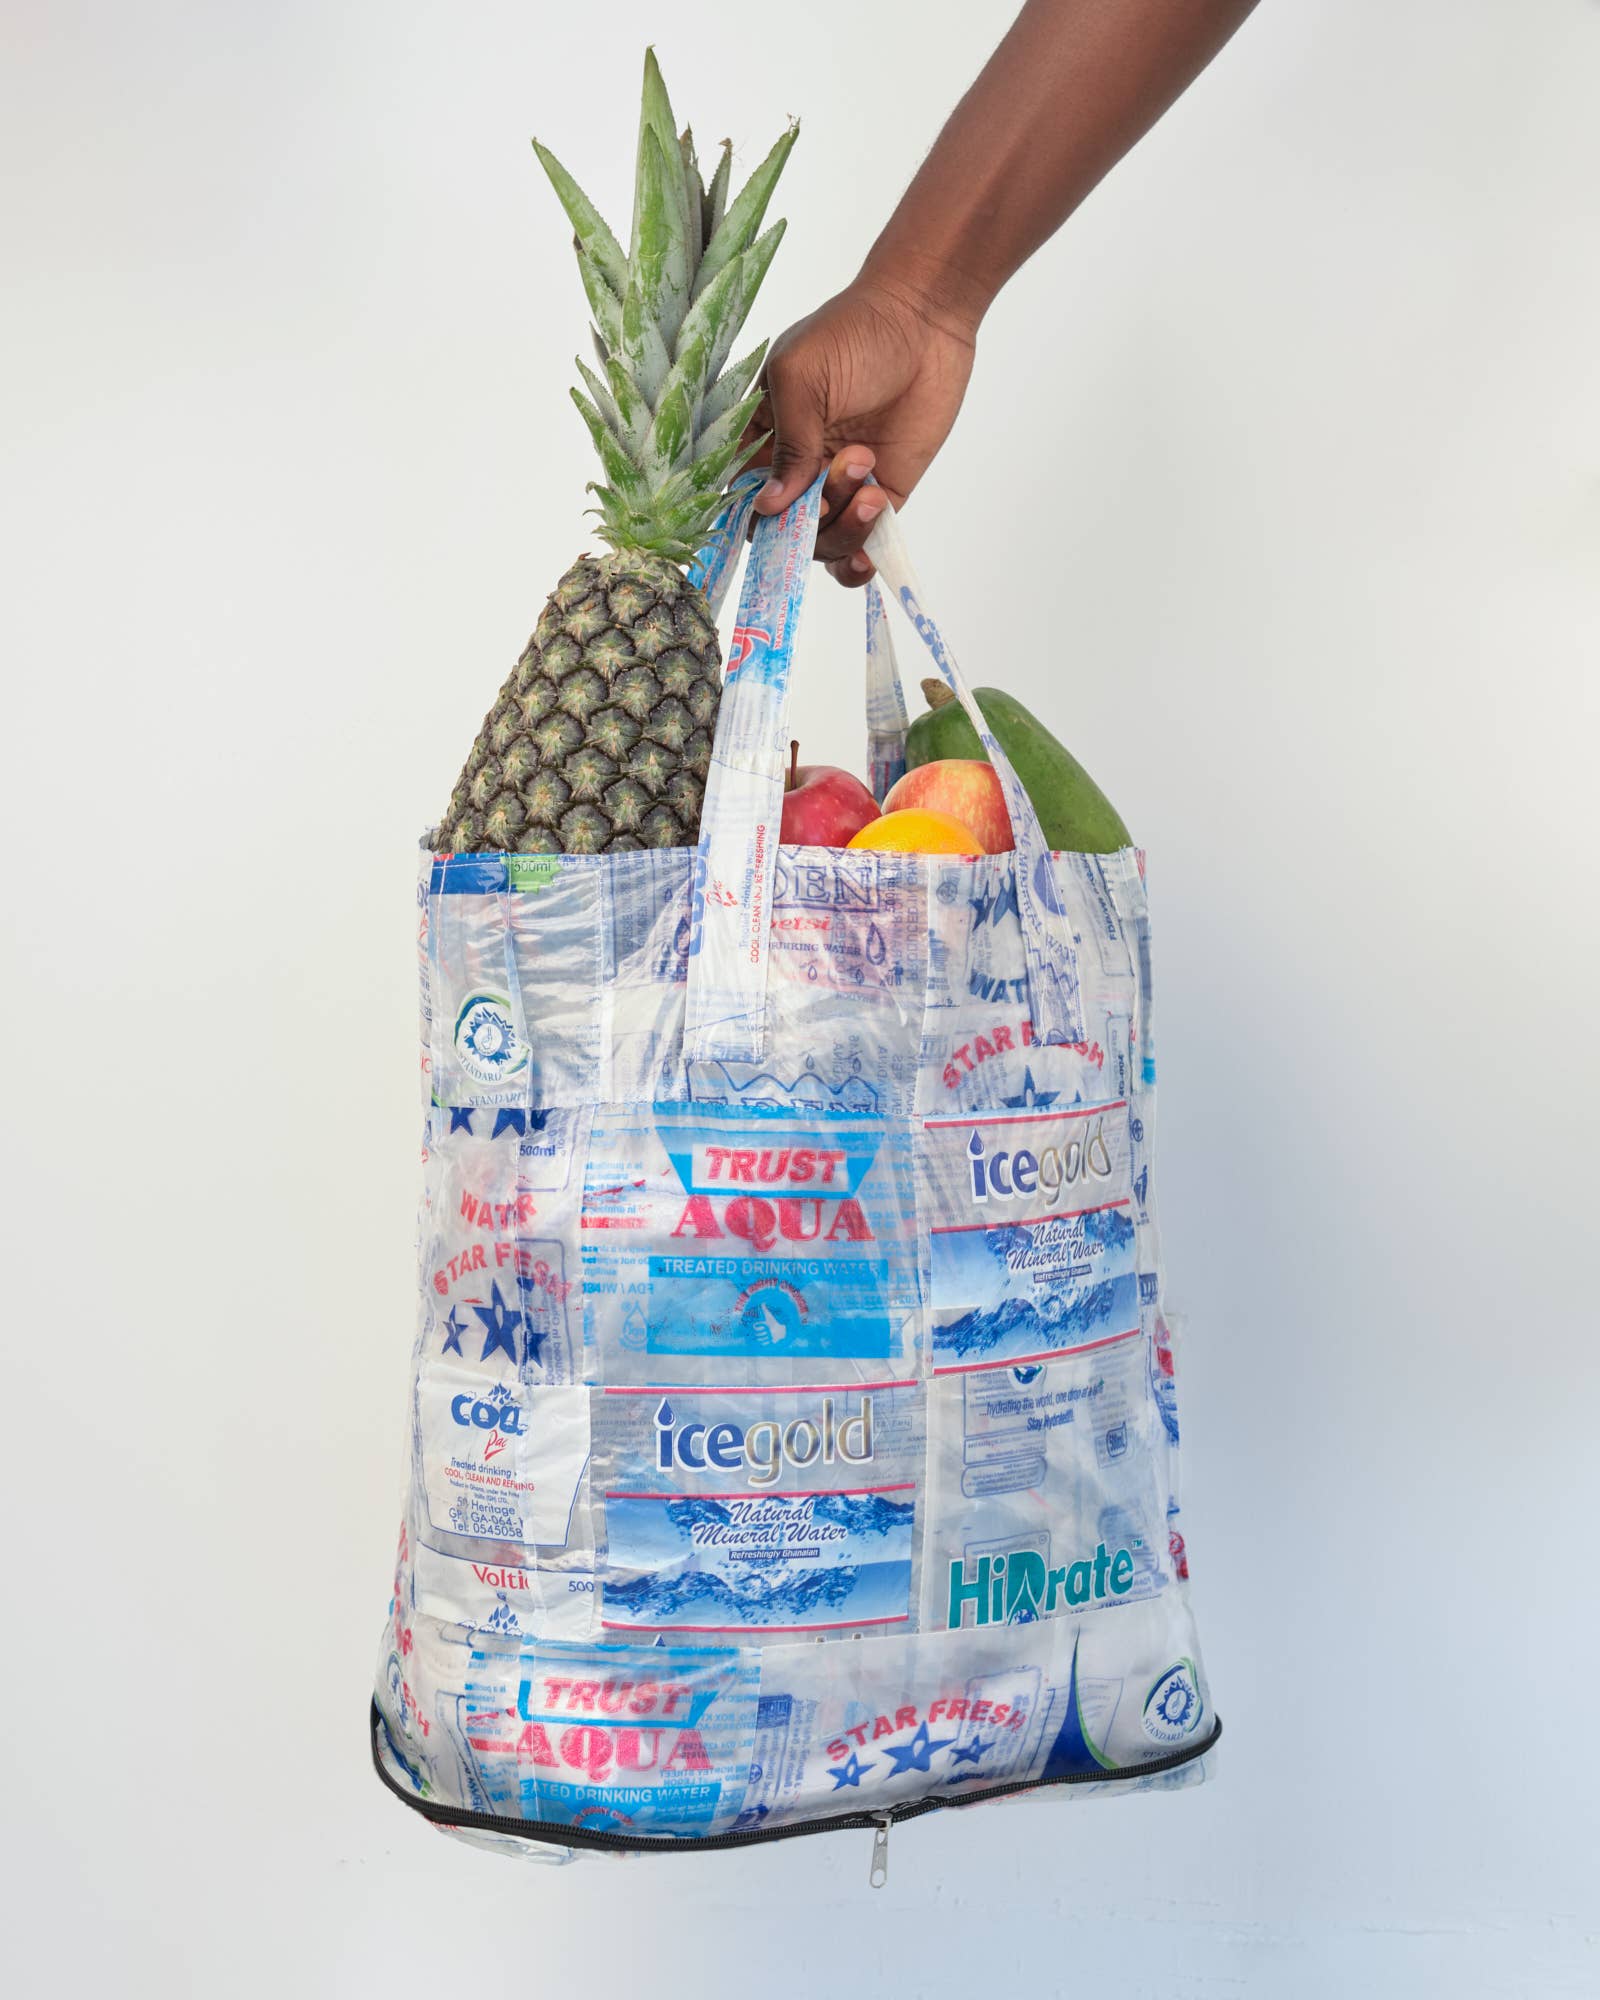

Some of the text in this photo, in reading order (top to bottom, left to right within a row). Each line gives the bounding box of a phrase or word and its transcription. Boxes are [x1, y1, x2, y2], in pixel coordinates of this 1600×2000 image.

[773, 599, 789, 650] NATURAL
[783, 546, 799, 592] MINERAL
[793, 503, 808, 540] WATER
[740, 868, 755, 909] drinking
[751, 906, 762, 933] CLEAN
[823, 942, 861, 955] WATER
[970, 968, 1027, 1004] WAT
[943, 1025, 1016, 1090] STAR
[519, 1144, 556, 1157] 500ml
[967, 1116, 1112, 1206] icegold
[704, 1146, 847, 1184] TRUST
[670, 1194, 876, 1253] AQUA
[1032, 1220, 1085, 1246] Natural
[662, 1258, 738, 1275] TREATED
[741, 1259, 819, 1276] DRINKING
[1006, 1240, 1067, 1272] Mineral
[433, 1243, 489, 1297] STAR
[1026, 1414, 1043, 1433] Stay
[484, 1429, 508, 1455] Pac
[654, 1396, 874, 1488] icegold
[444, 1467, 464, 1480] COOL,
[465, 1472, 485, 1484] CLEAN
[486, 1477, 501, 1486] AND
[451, 1457, 512, 1479] Treated drinking
[471, 1500, 516, 1517] Heritage
[729, 1501, 814, 1525] Natural
[452, 1519, 523, 1537] Tel: 0545058
[690, 1521, 848, 1546] Mineral Water
[730, 1547, 818, 1561] Refreshingly Ghanaian
[568, 1580, 594, 1593] 500
[947, 1543, 1134, 1630] HiDrate
[543, 1677, 694, 1715] TRUST
[826, 1704, 918, 1762] STAR
[928, 1698, 1027, 1734] FRESH
[517, 1722, 715, 1783] AQUA
[575, 1784, 653, 1803] DRINKING
[656, 1785, 710, 1800] WATER
